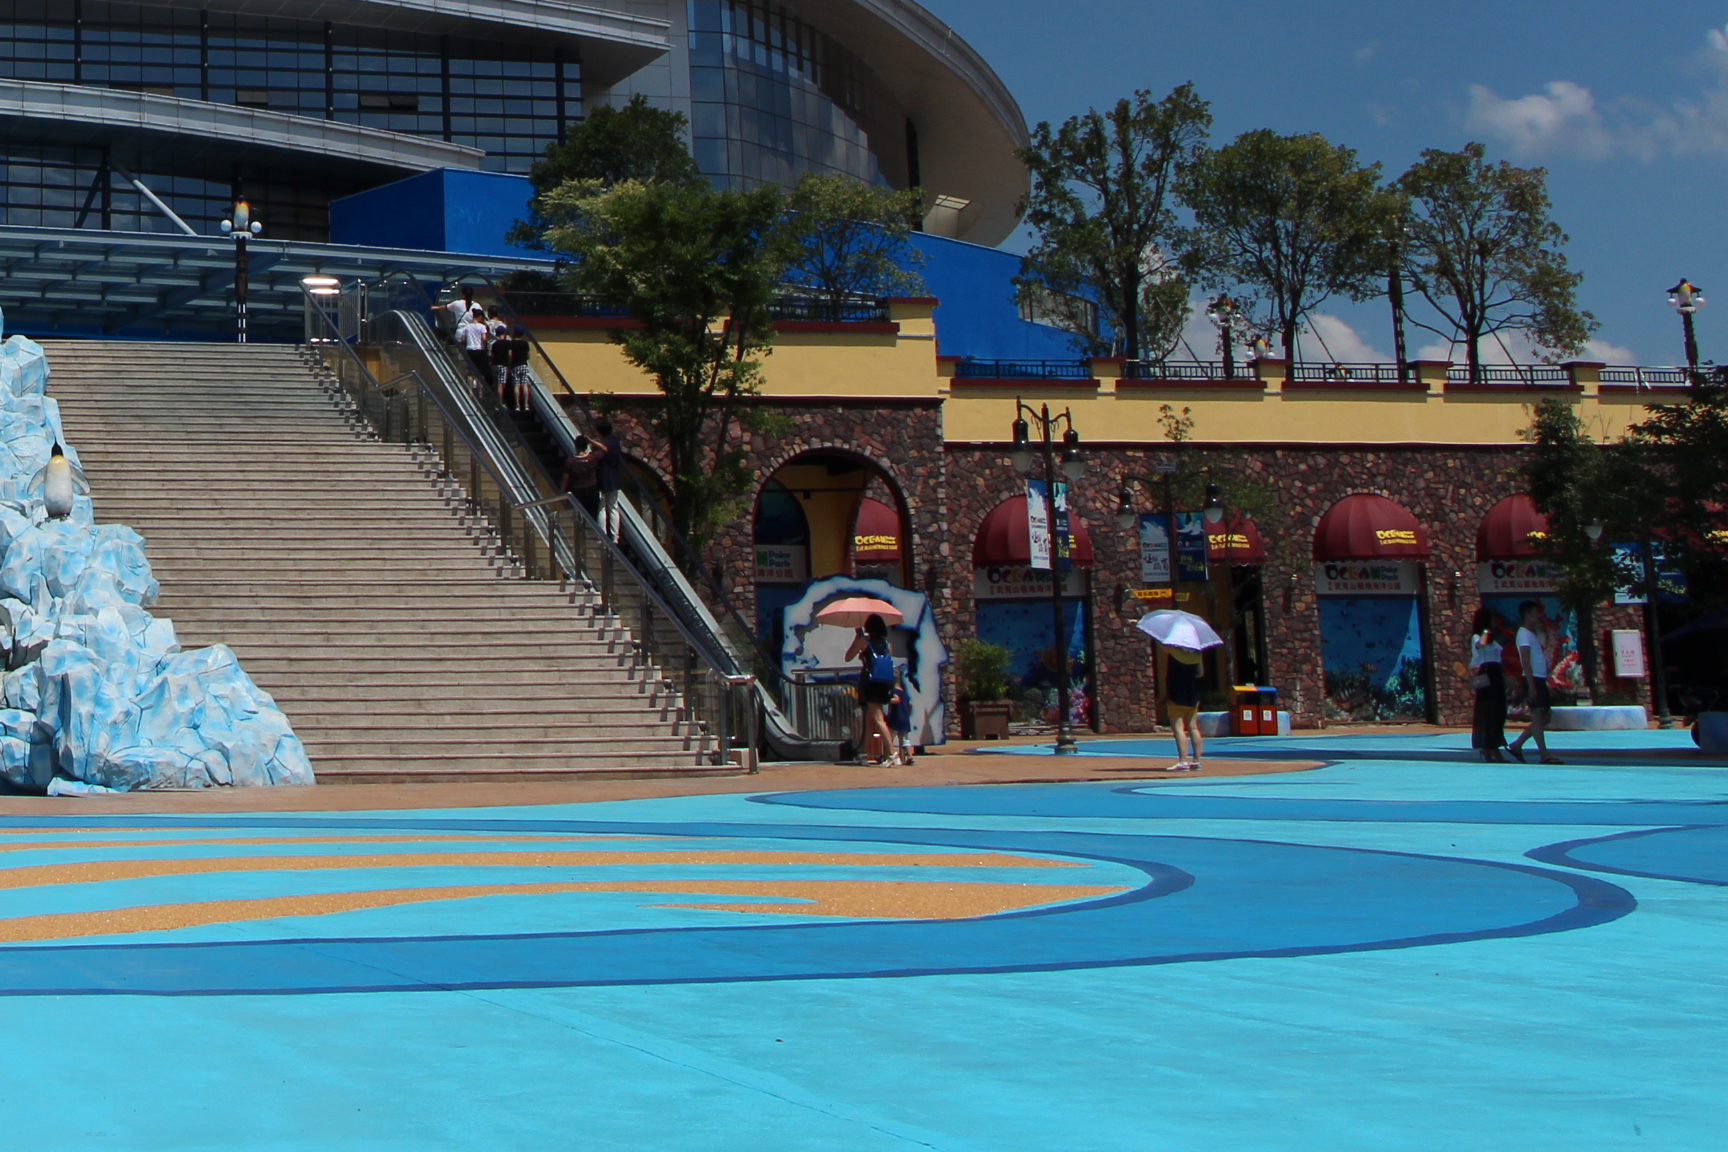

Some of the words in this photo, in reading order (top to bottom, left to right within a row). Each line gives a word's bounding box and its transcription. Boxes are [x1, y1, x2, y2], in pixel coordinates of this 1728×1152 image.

[768, 551, 791, 559] Polar
[987, 567, 1046, 584] OCEAN
[1325, 564, 1381, 580] OCEAN
[1491, 563, 1546, 579] OCEAN
